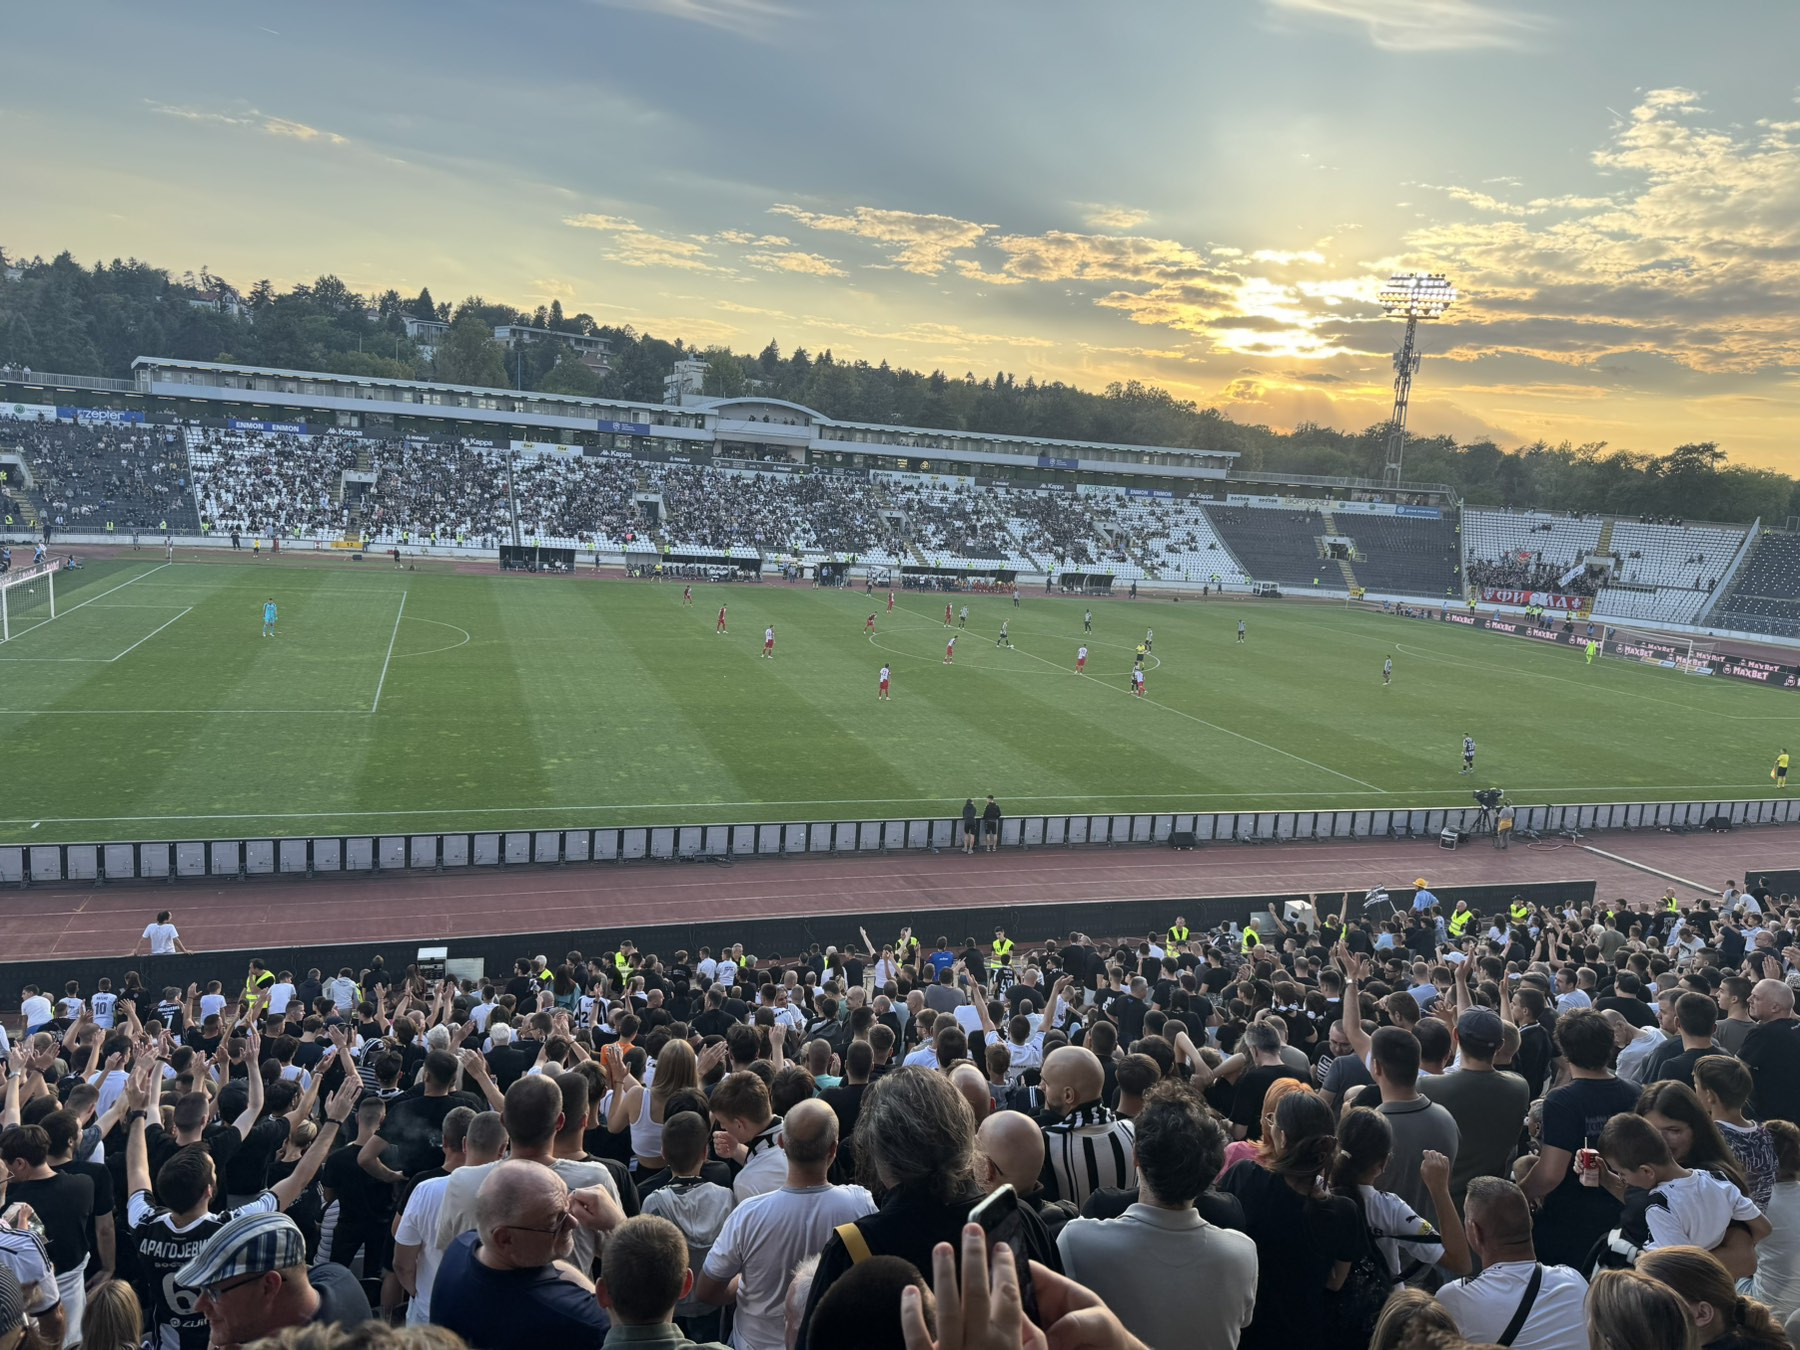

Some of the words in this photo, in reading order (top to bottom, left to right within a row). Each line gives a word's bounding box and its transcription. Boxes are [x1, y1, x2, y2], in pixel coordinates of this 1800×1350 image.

[236, 421, 264, 430] ENMON
[338, 428, 362, 437] Kappa
[470, 438, 493, 446] Kappa
[610, 450, 632, 458] Kappa
[1624, 645, 1654, 657] MAXBET
[1733, 666, 1768, 680] MAXBET
[94, 1002, 107, 1015] 10
[139, 1239, 210, 1258] ДРАГОЈЕВИ
[162, 1272, 200, 1315] 6
